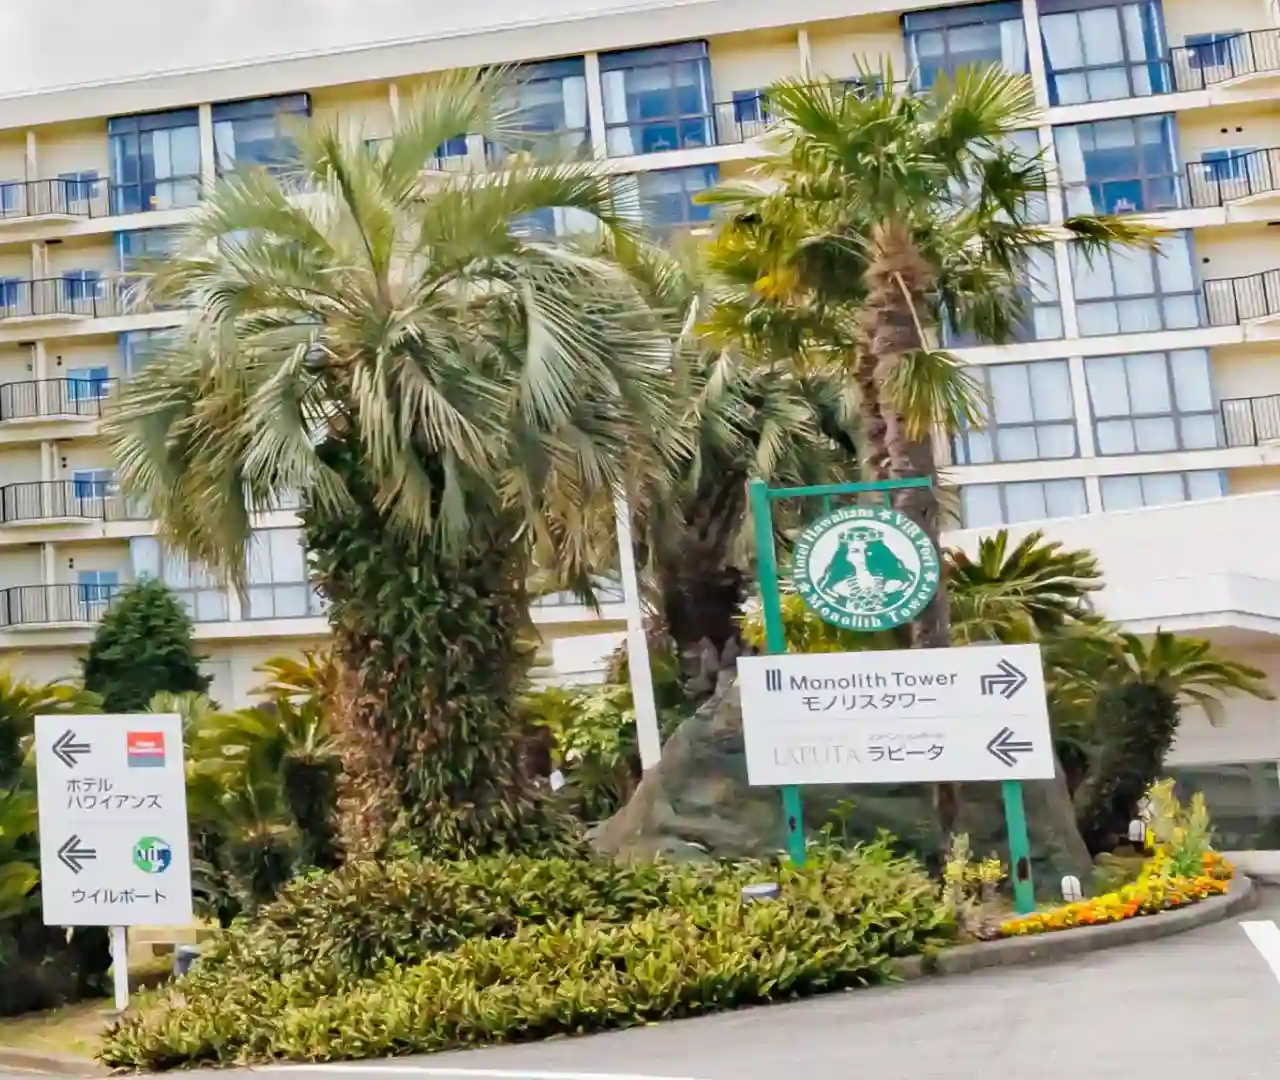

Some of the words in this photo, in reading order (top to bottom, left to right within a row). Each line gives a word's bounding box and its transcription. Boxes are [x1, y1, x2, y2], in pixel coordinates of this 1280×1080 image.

[886, 584, 932, 623] Tower
[790, 672, 887, 691] Monolith
[891, 671, 958, 687] Tower
[801, 692, 937, 712] モノリスタワー
[66, 777, 113, 793] ホテル
[66, 793, 163, 810] ハワイアンズ
